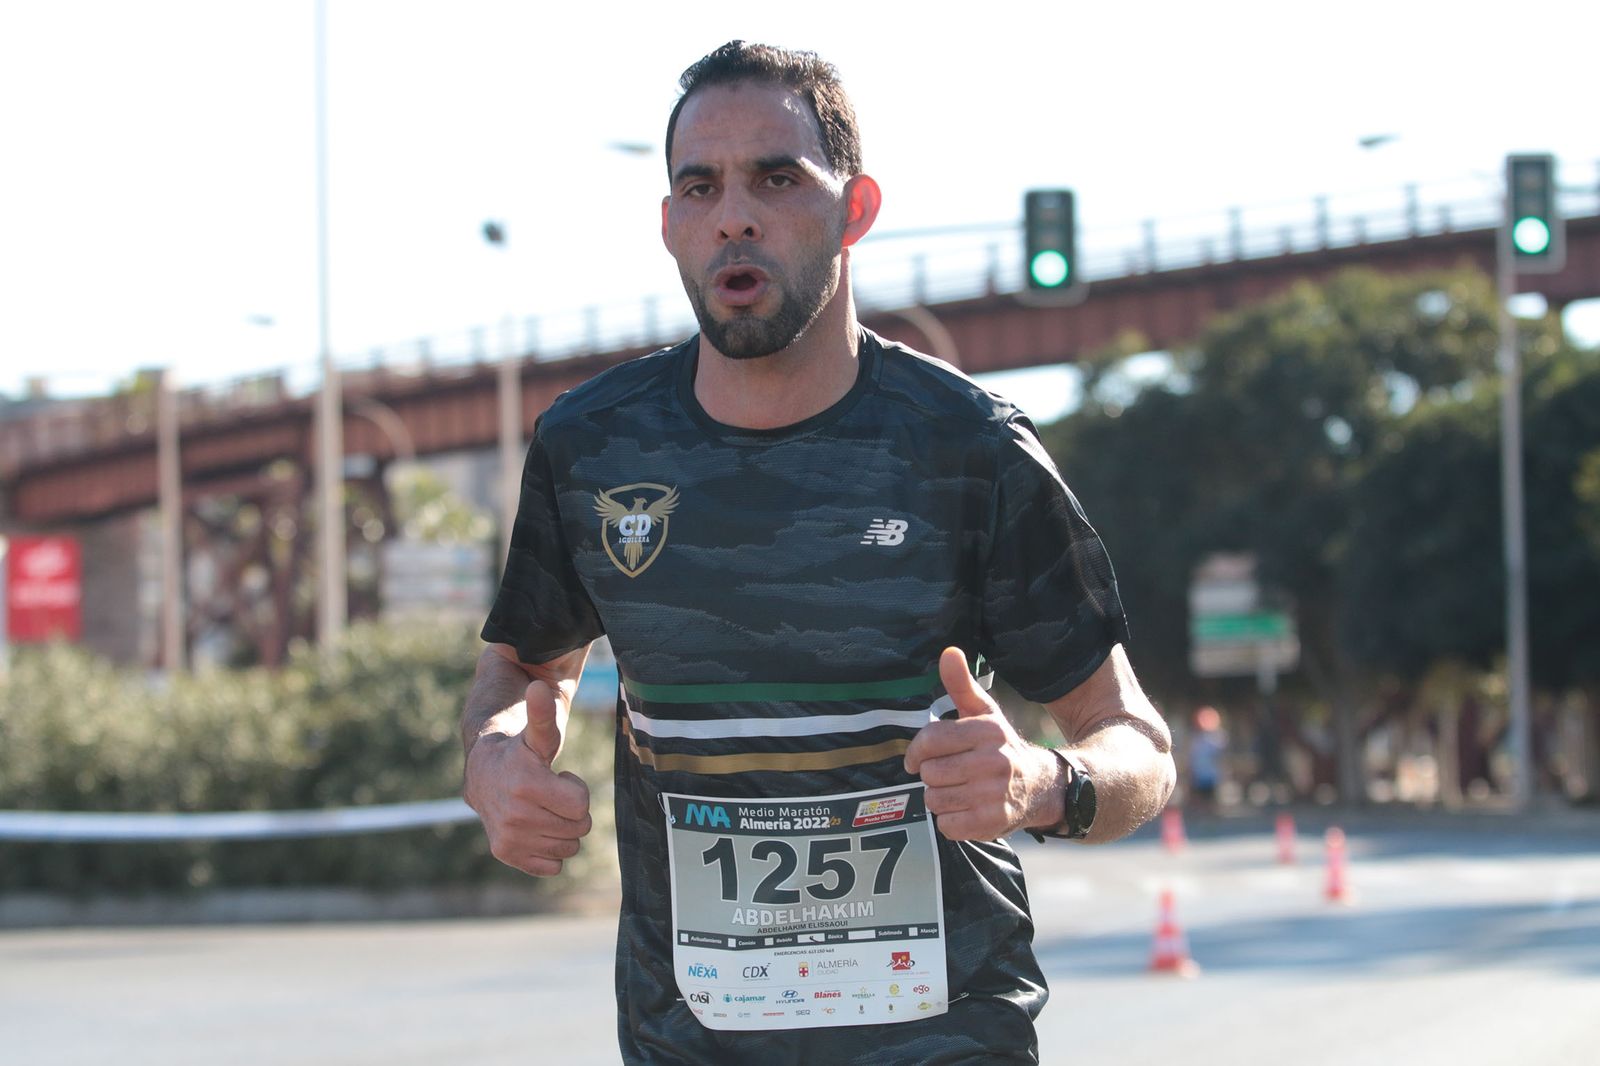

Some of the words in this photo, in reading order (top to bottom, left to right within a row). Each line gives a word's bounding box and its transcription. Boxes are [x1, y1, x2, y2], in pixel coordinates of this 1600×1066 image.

[618, 513, 652, 537] CD
[738, 807, 775, 818] Medio
[779, 805, 831, 817] Maratón
[739, 817, 792, 830] Almería
[702, 828, 909, 905] 1257
[731, 900, 875, 926] ABDELHAKIM
[757, 923, 807, 934] ABDELHAKIM
[808, 920, 849, 929] ELISSAOUI
[817, 958, 859, 969] ALMERÍA
[688, 963, 718, 979] NEXA
[742, 964, 769, 978] CDX
[814, 991, 842, 999] Blanes
[912, 984, 930, 995] ego
[734, 995, 766, 1003] cajamar
